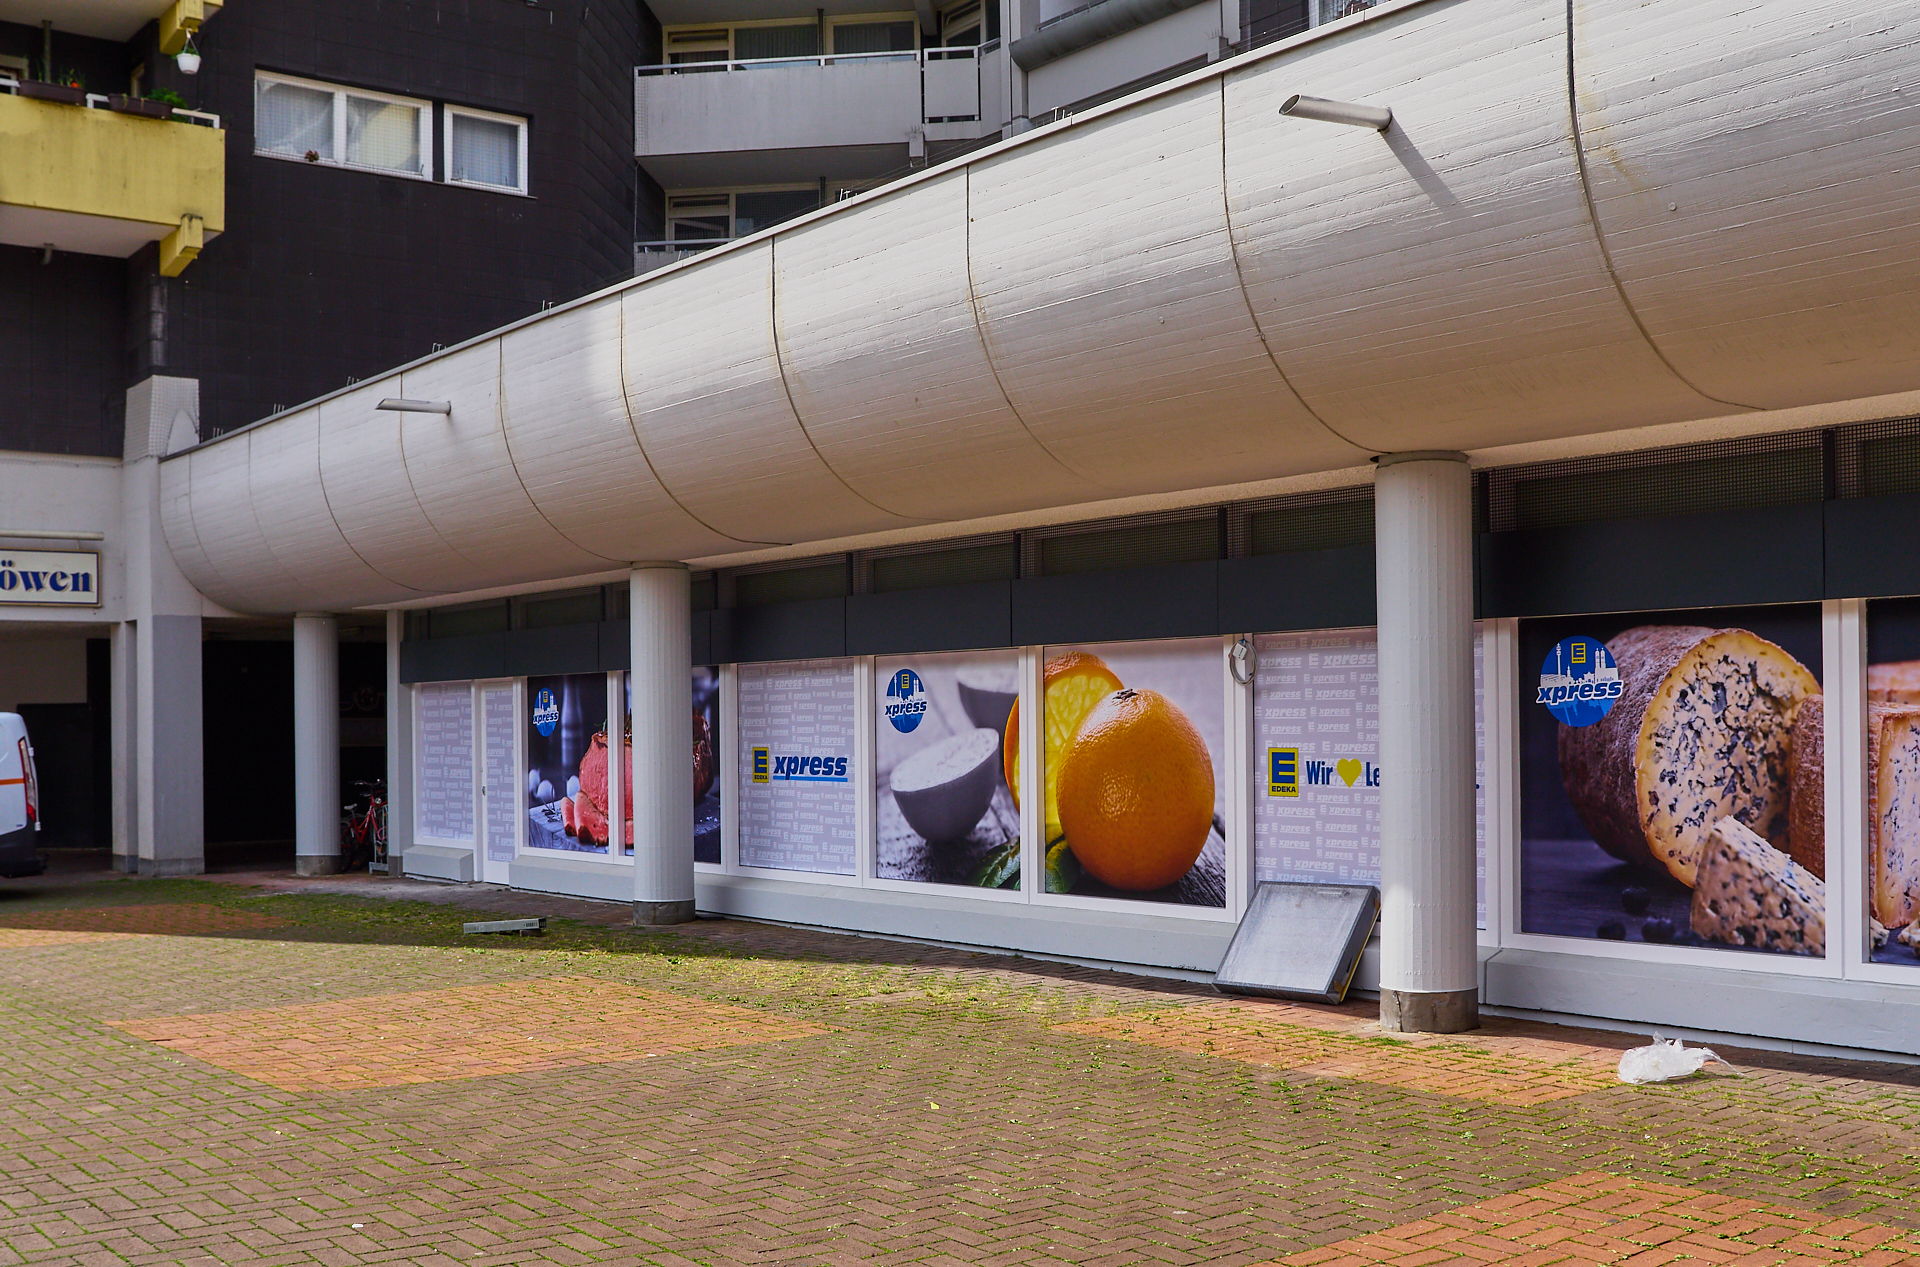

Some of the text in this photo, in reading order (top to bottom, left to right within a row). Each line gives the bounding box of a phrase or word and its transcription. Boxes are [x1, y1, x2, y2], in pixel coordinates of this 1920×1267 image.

[0, 560, 92, 592] öwen
[1311, 638, 1350, 648] xpress
[1573, 645, 1584, 657] E
[1261, 657, 1301, 667] xpress
[1309, 653, 1376, 666] E xpress
[903, 676, 908, 684] E
[1266, 675, 1296, 683] xpress
[1313, 674, 1345, 682] xpress
[1270, 691, 1301, 699] xpress
[1305, 688, 1355, 698] E xpress
[1536, 680, 1623, 704] xpress
[885, 701, 927, 716] xpress
[1255, 706, 1306, 718] E xpress
[1319, 708, 1350, 716] xpress
[534, 712, 558, 724] xpress
[1271, 725, 1302, 734] xpress
[1317, 722, 1350, 731] xpress
[1323, 741, 1375, 752] E xpress
[754, 750, 847, 780] E xpress
[1272, 752, 1295, 783] E
[1306, 761, 1333, 785] Wir
[1317, 794, 1349, 802] xpress
[1267, 805, 1274, 814] E
[1277, 807, 1315, 816] xpress
[1329, 807, 1361, 815] xpress
[1280, 824, 1310, 833] xpress
[1325, 822, 1357, 831] xpress
[1279, 839, 1310, 848] xpress
[1325, 839, 1358, 848] xpress
[1325, 851, 1353, 859] xpress
[1359, 853, 1367, 864] E
[1284, 858, 1334, 870] E xpress
[1266, 870, 1273, 879] E
[1340, 866, 1348, 877] E
